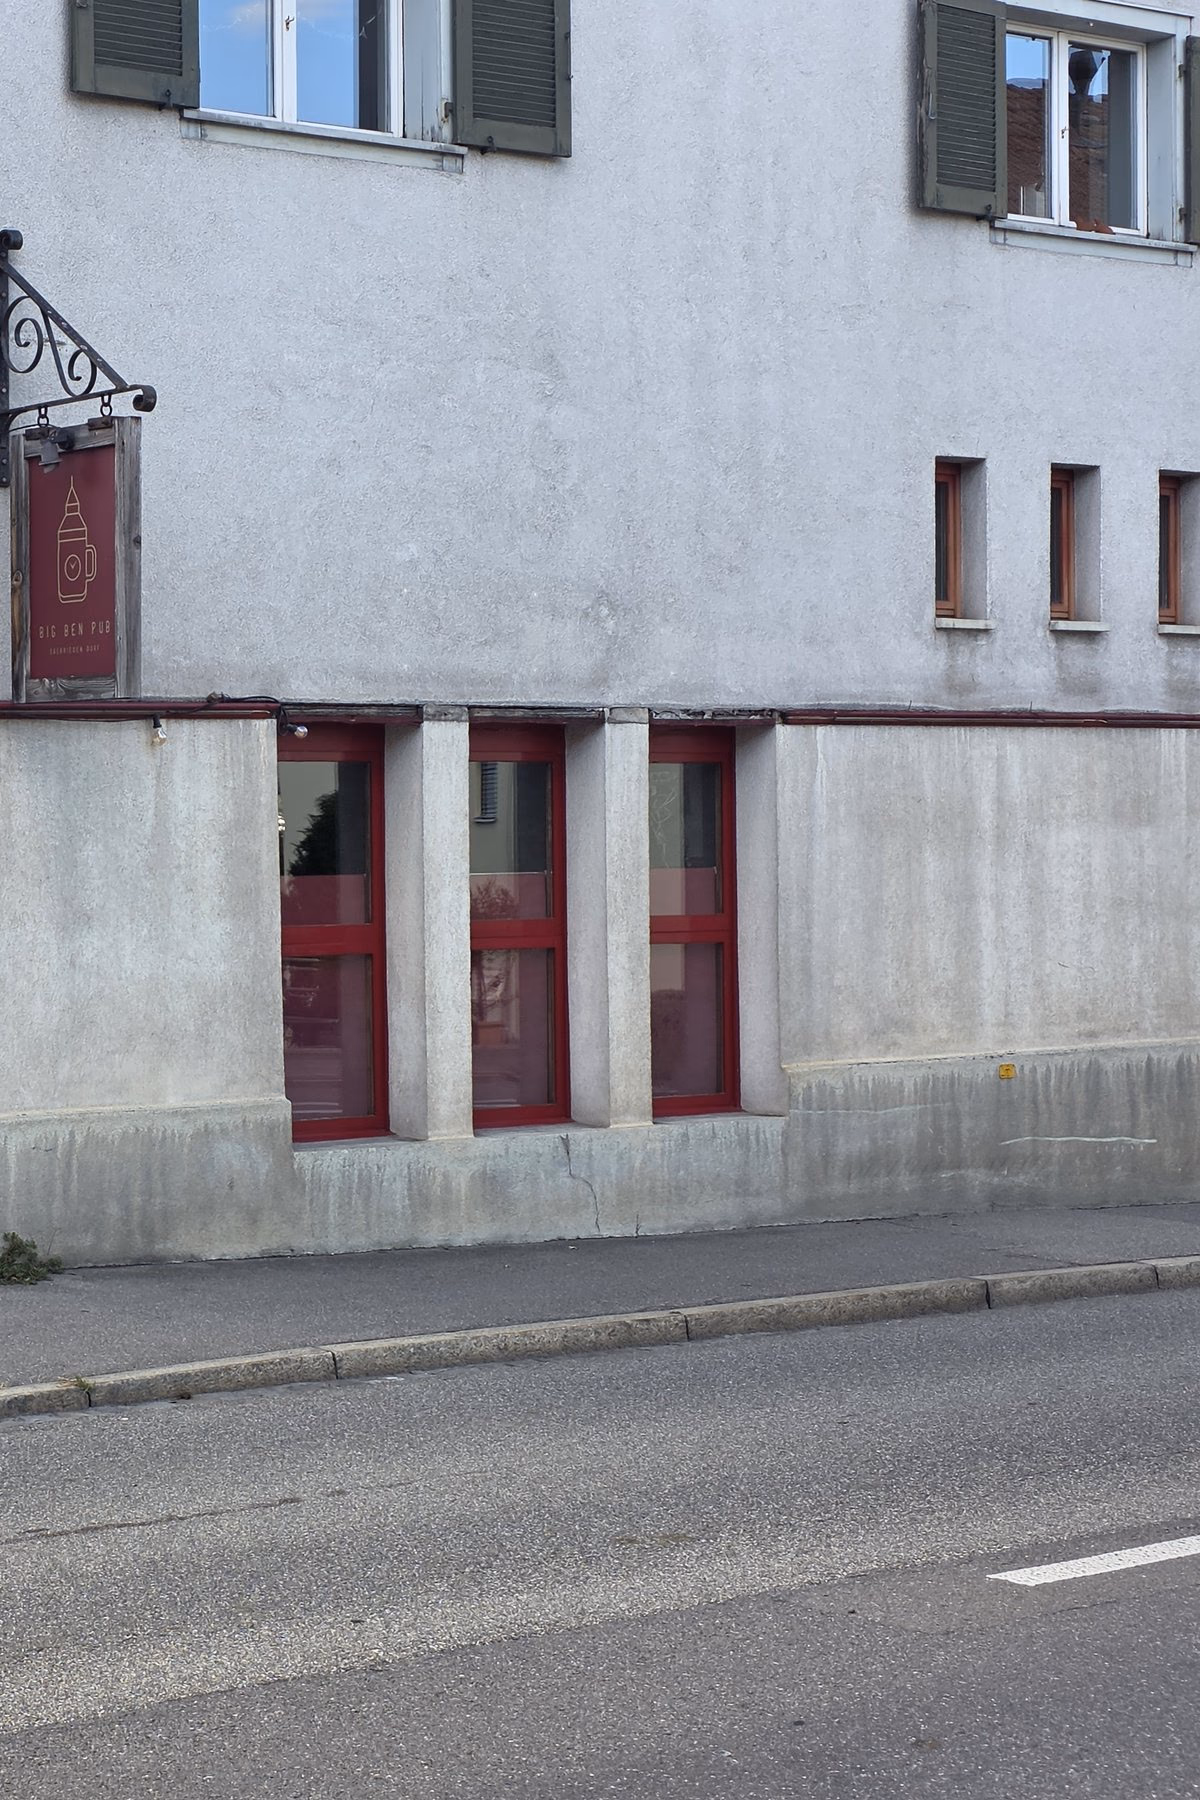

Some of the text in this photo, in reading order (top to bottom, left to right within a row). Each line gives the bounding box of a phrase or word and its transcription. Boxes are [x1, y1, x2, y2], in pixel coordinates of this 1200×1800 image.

[39, 620, 111, 639] BIG BEN PUB
